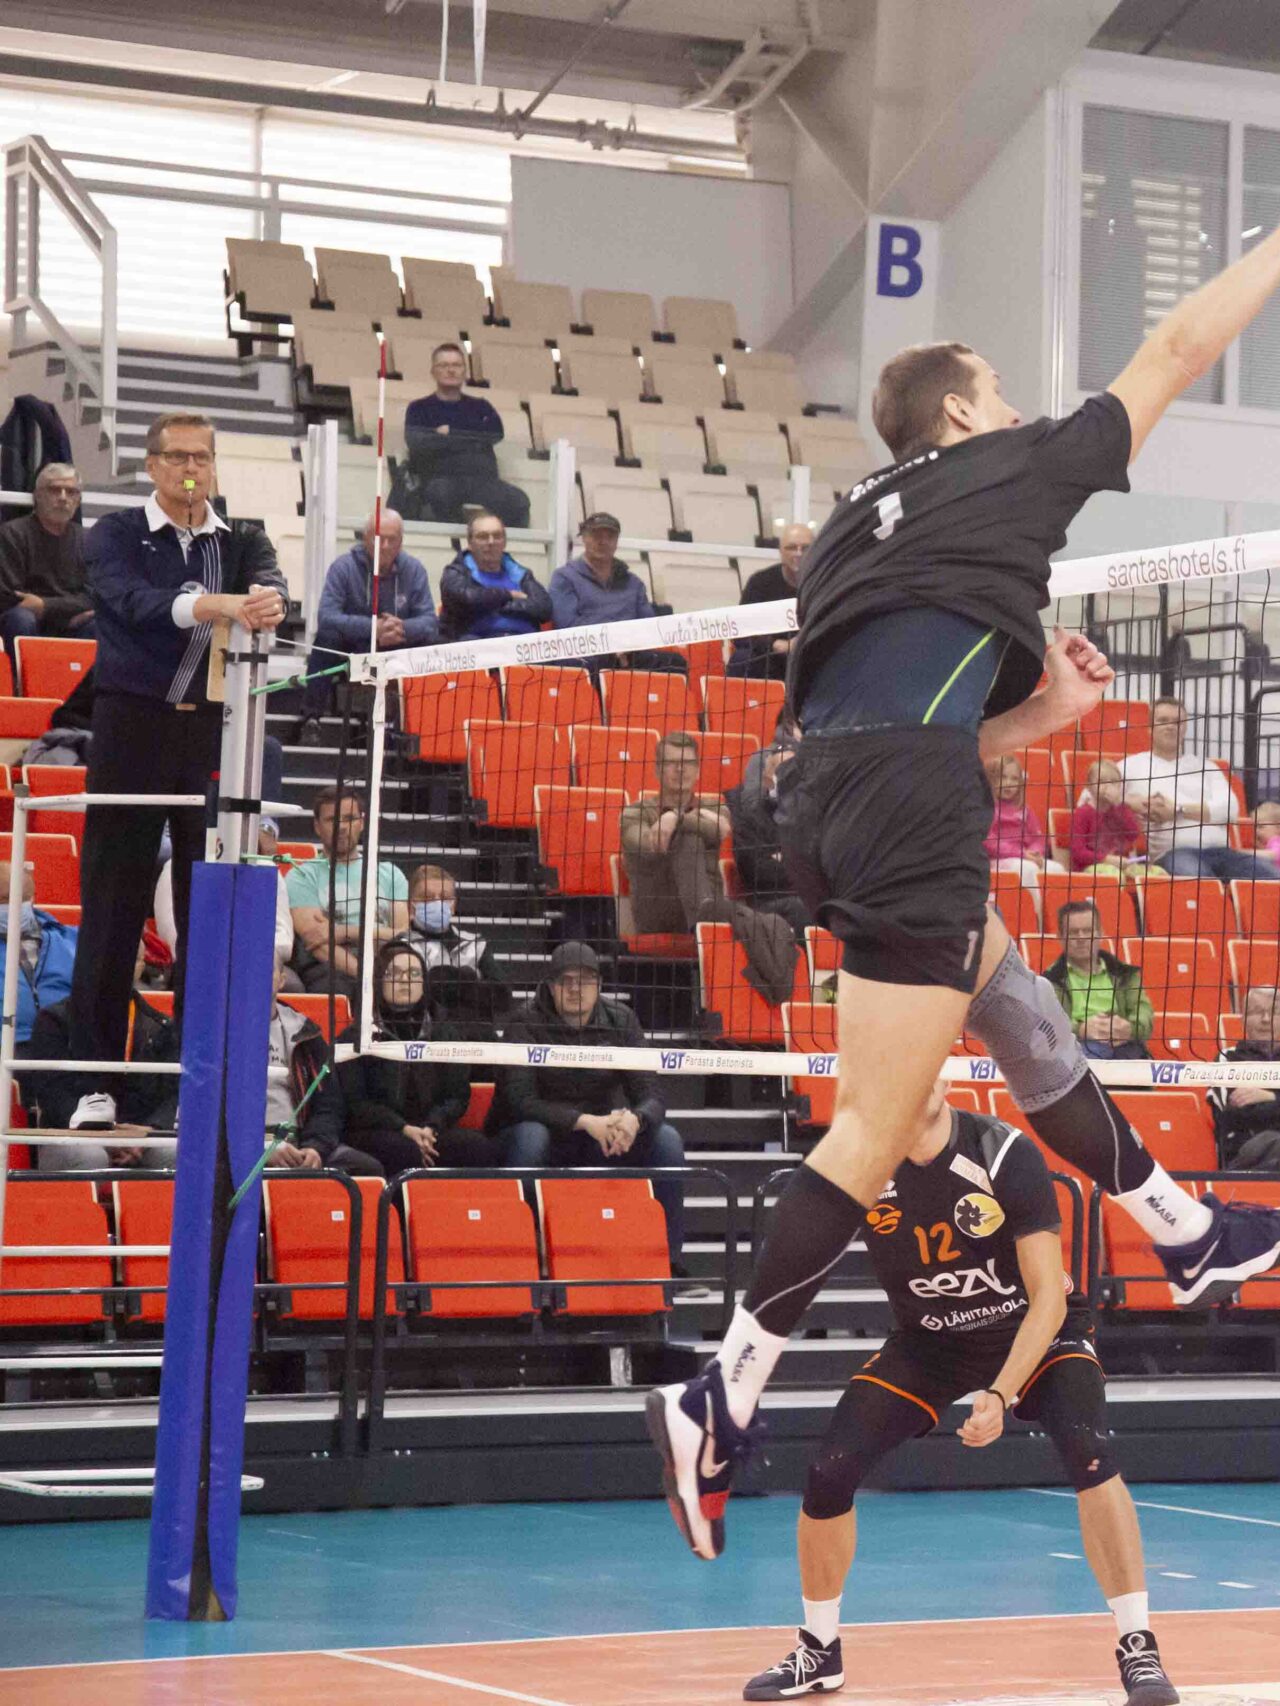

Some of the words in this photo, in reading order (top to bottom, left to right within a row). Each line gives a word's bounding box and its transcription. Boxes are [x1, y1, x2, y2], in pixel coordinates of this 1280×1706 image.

[876, 222, 923, 298] B
[1107, 537, 1247, 588] santashotels.fi
[699, 615, 739, 640] Hotels
[515, 625, 610, 663] santashotels.fi
[444, 651, 476, 670] Hotels
[403, 1043, 426, 1060] YBT
[527, 1046, 551, 1064] YBT
[660, 1051, 685, 1070] YBT
[685, 1055, 714, 1068] Parasta
[807, 1056, 836, 1075] YBT
[970, 1059, 997, 1079] YBT
[1150, 1062, 1186, 1084] YBT
[1184, 1067, 1224, 1080] Parasta
[913, 1221, 961, 1265] 12
[944, 1298, 1028, 1327] LÄHITAPIOLA
